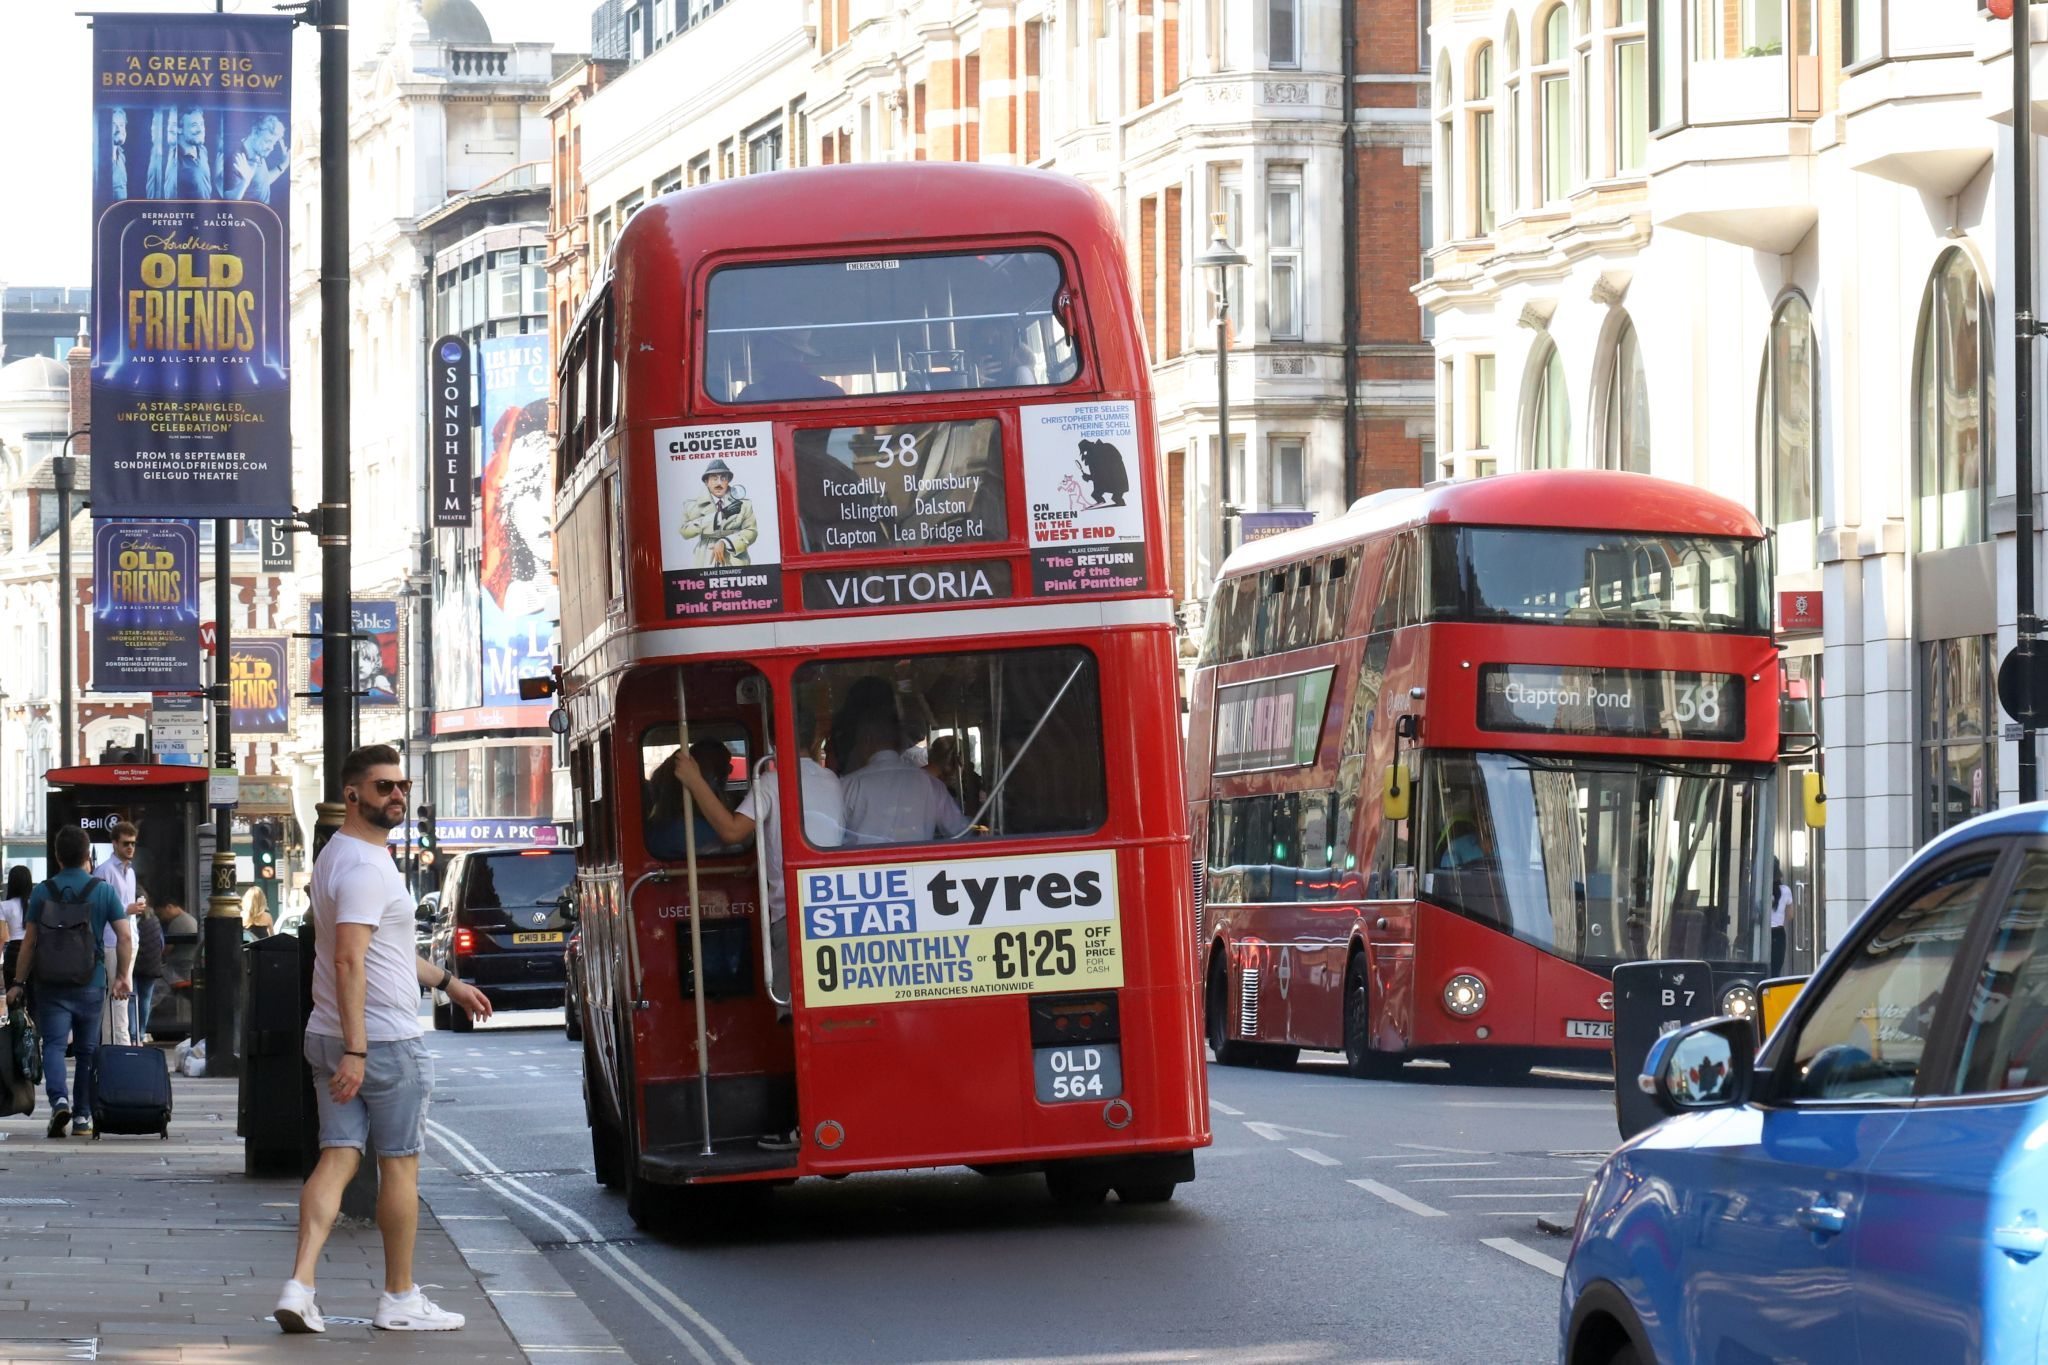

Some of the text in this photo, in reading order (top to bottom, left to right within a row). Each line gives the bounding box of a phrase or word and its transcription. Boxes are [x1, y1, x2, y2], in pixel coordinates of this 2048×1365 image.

[148, 56, 212, 72] GREAT
[219, 57, 253, 72] BIG
[102, 72, 214, 87] BROADWAY
[142, 212, 195, 220] BERNADETTE
[152, 219, 246, 227] PETERS SALONGA
[141, 252, 243, 289] OLD
[884, 260, 898, 269] EXIT
[128, 290, 255, 351] FRIENDS
[161, 356, 217, 364] ALL-STAR
[222, 356, 251, 364] CAST
[1074, 404, 1130, 415] PETER SELLERS
[116, 412, 265, 423] UNFORGETTABLE MUSICAL
[1041, 412, 1130, 425] CHRISTOPHER PLUMMER
[1061, 420, 1131, 432] CATHERINE SCHELL
[1080, 428, 1131, 438] HERBERT LOM
[443, 366, 460, 512] SONDHEIM
[683, 428, 741, 440] INSPECTOR
[669, 436, 758, 454] CLOUSEAU
[873, 432, 919, 469] 38
[136, 451, 246, 461] FROM 16 SEPTEMBER
[670, 450, 758, 462] THE GREAT RETURNS
[114, 461, 268, 471] SONDHEIMOLDFRIENDS.COM
[143, 471, 239, 481] GIELGUD THEATRE
[823, 473, 981, 498] Piccadilly Bloomsbury
[840, 498, 967, 523] Islington Dalston
[1033, 503, 1050, 512] ON
[1033, 510, 1078, 521] SCREEN
[1034, 519, 1073, 530] IN THE
[1261, 527, 1285, 535] GREAT
[826, 519, 984, 549] Clapton Lea Bridge Rd
[1034, 527, 1079, 543] WEST
[1082, 526, 1116, 539] END
[1071, 547, 1087, 555] BLAKE
[118, 550, 175, 571] OLD
[264, 558, 292, 566] THEATRE
[1077, 552, 1134, 567] RETURN
[703, 569, 718, 577] BLAKE
[1072, 566, 1110, 578] of the
[112, 570, 181, 603] FRIENDS
[708, 574, 768, 590] RETURN
[826, 568, 995, 607] VICTORIA
[1044, 579, 1078, 592] Pink
[704, 588, 743, 601] of the
[675, 601, 709, 615] Pink
[1505, 682, 1720, 723] Clapton Pond 38
[80, 817, 103, 829] Bell
[470, 825, 490, 839] OF
[494, 826, 504, 838] A
[808, 869, 909, 904] BLUE
[926, 869, 1102, 926] tyres
[700, 902, 755, 917] TICKETS
[811, 902, 911, 938] STAR
[1084, 926, 1112, 938] OFF
[840, 934, 970, 967] MONTHLY
[1085, 939, 1107, 948] LIST
[1085, 947, 1116, 957] PRICE
[816, 944, 838, 993] 9
[976, 953, 987, 963] or
[1086, 957, 1104, 966] FOR
[842, 961, 974, 990] PAYMENTS
[1086, 965, 1110, 974] CASH
[894, 981, 1035, 999] 270 BRANCHES NATIONWIDE
[1661, 989, 1696, 1006] B 7
[1574, 1022, 1601, 1036] LTZ
[1050, 1048, 1101, 1073] OLD
[1052, 1073, 1103, 1098] 564
